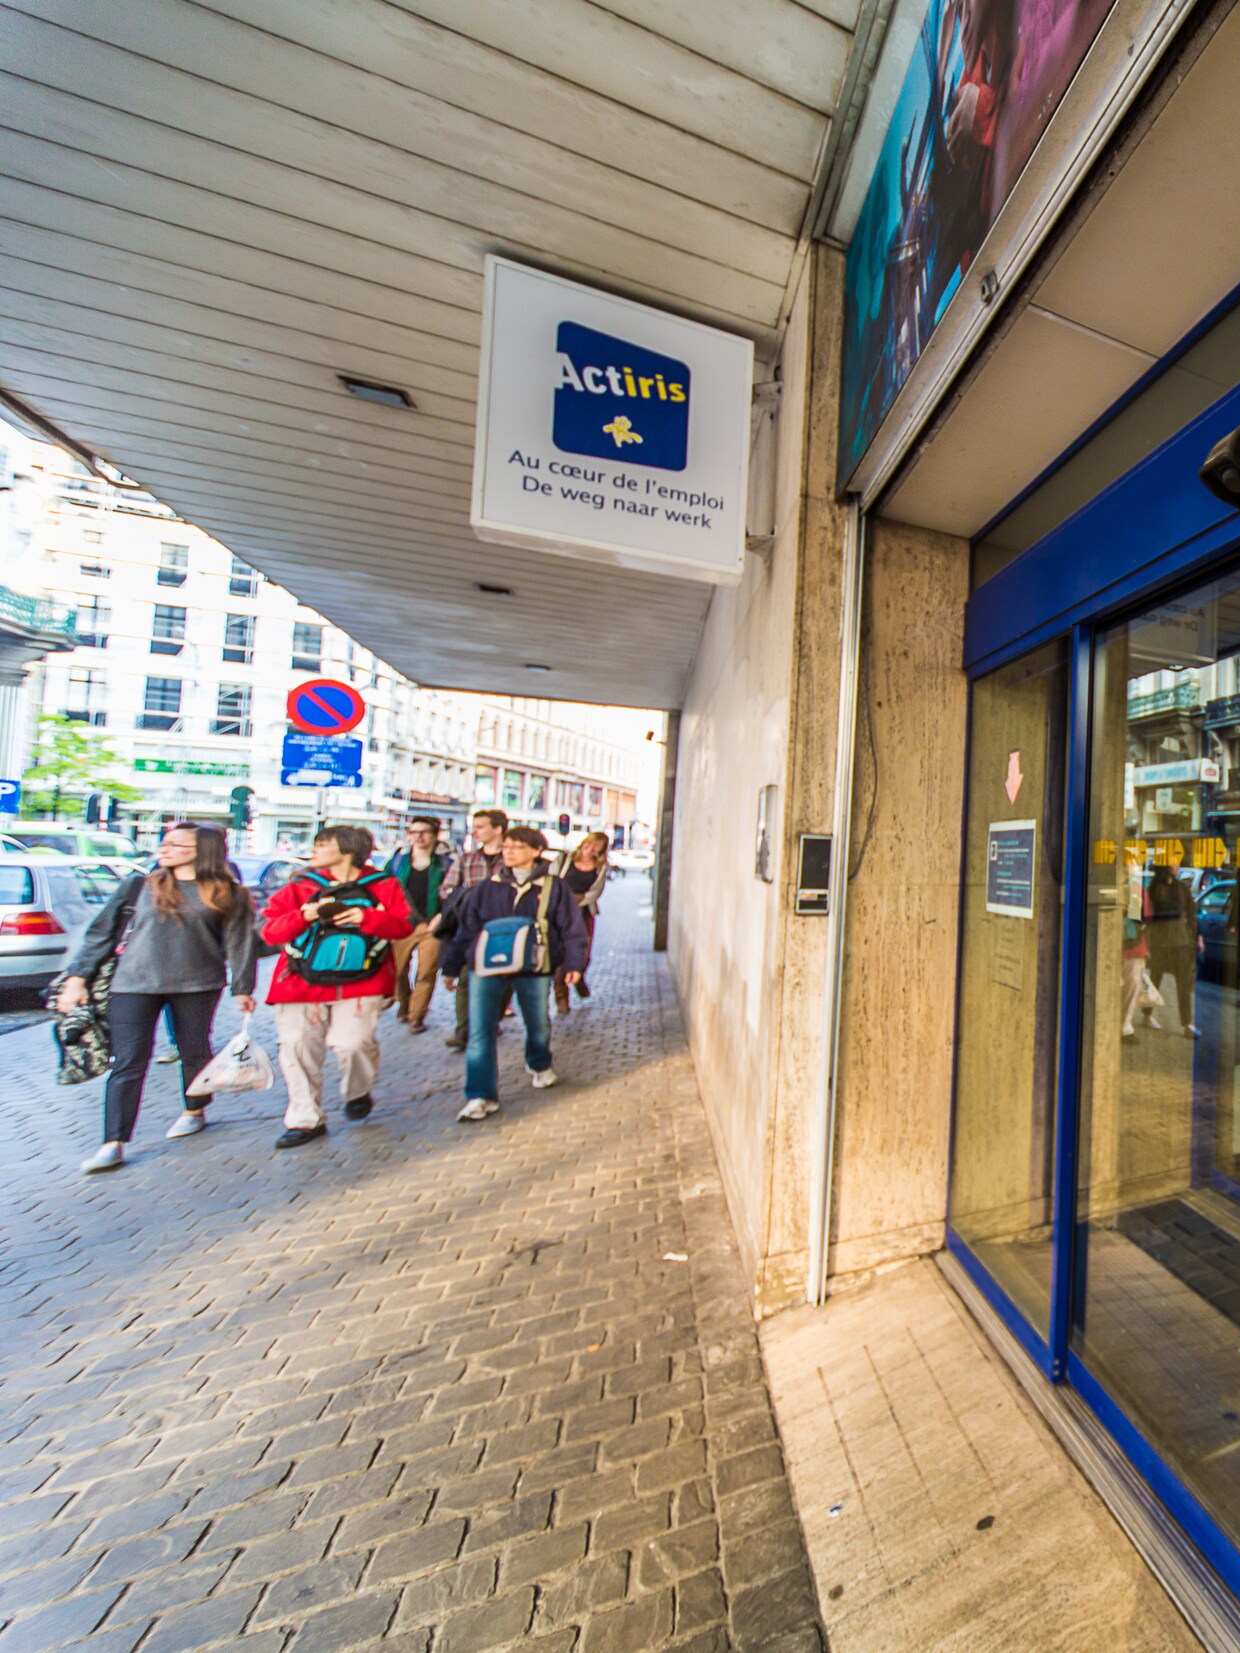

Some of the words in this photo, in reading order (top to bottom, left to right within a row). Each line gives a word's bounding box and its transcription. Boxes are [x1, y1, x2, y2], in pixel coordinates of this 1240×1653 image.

[554, 351, 686, 403] Actiris
[508, 449, 540, 470] Au
[548, 461, 606, 483] cœur
[612, 473, 638, 492] de
[645, 478, 724, 511] l’emploi
[522, 475, 553, 496] De
[560, 486, 605, 510] weg
[613, 497, 659, 517] naar
[664, 508, 712, 530] werk
